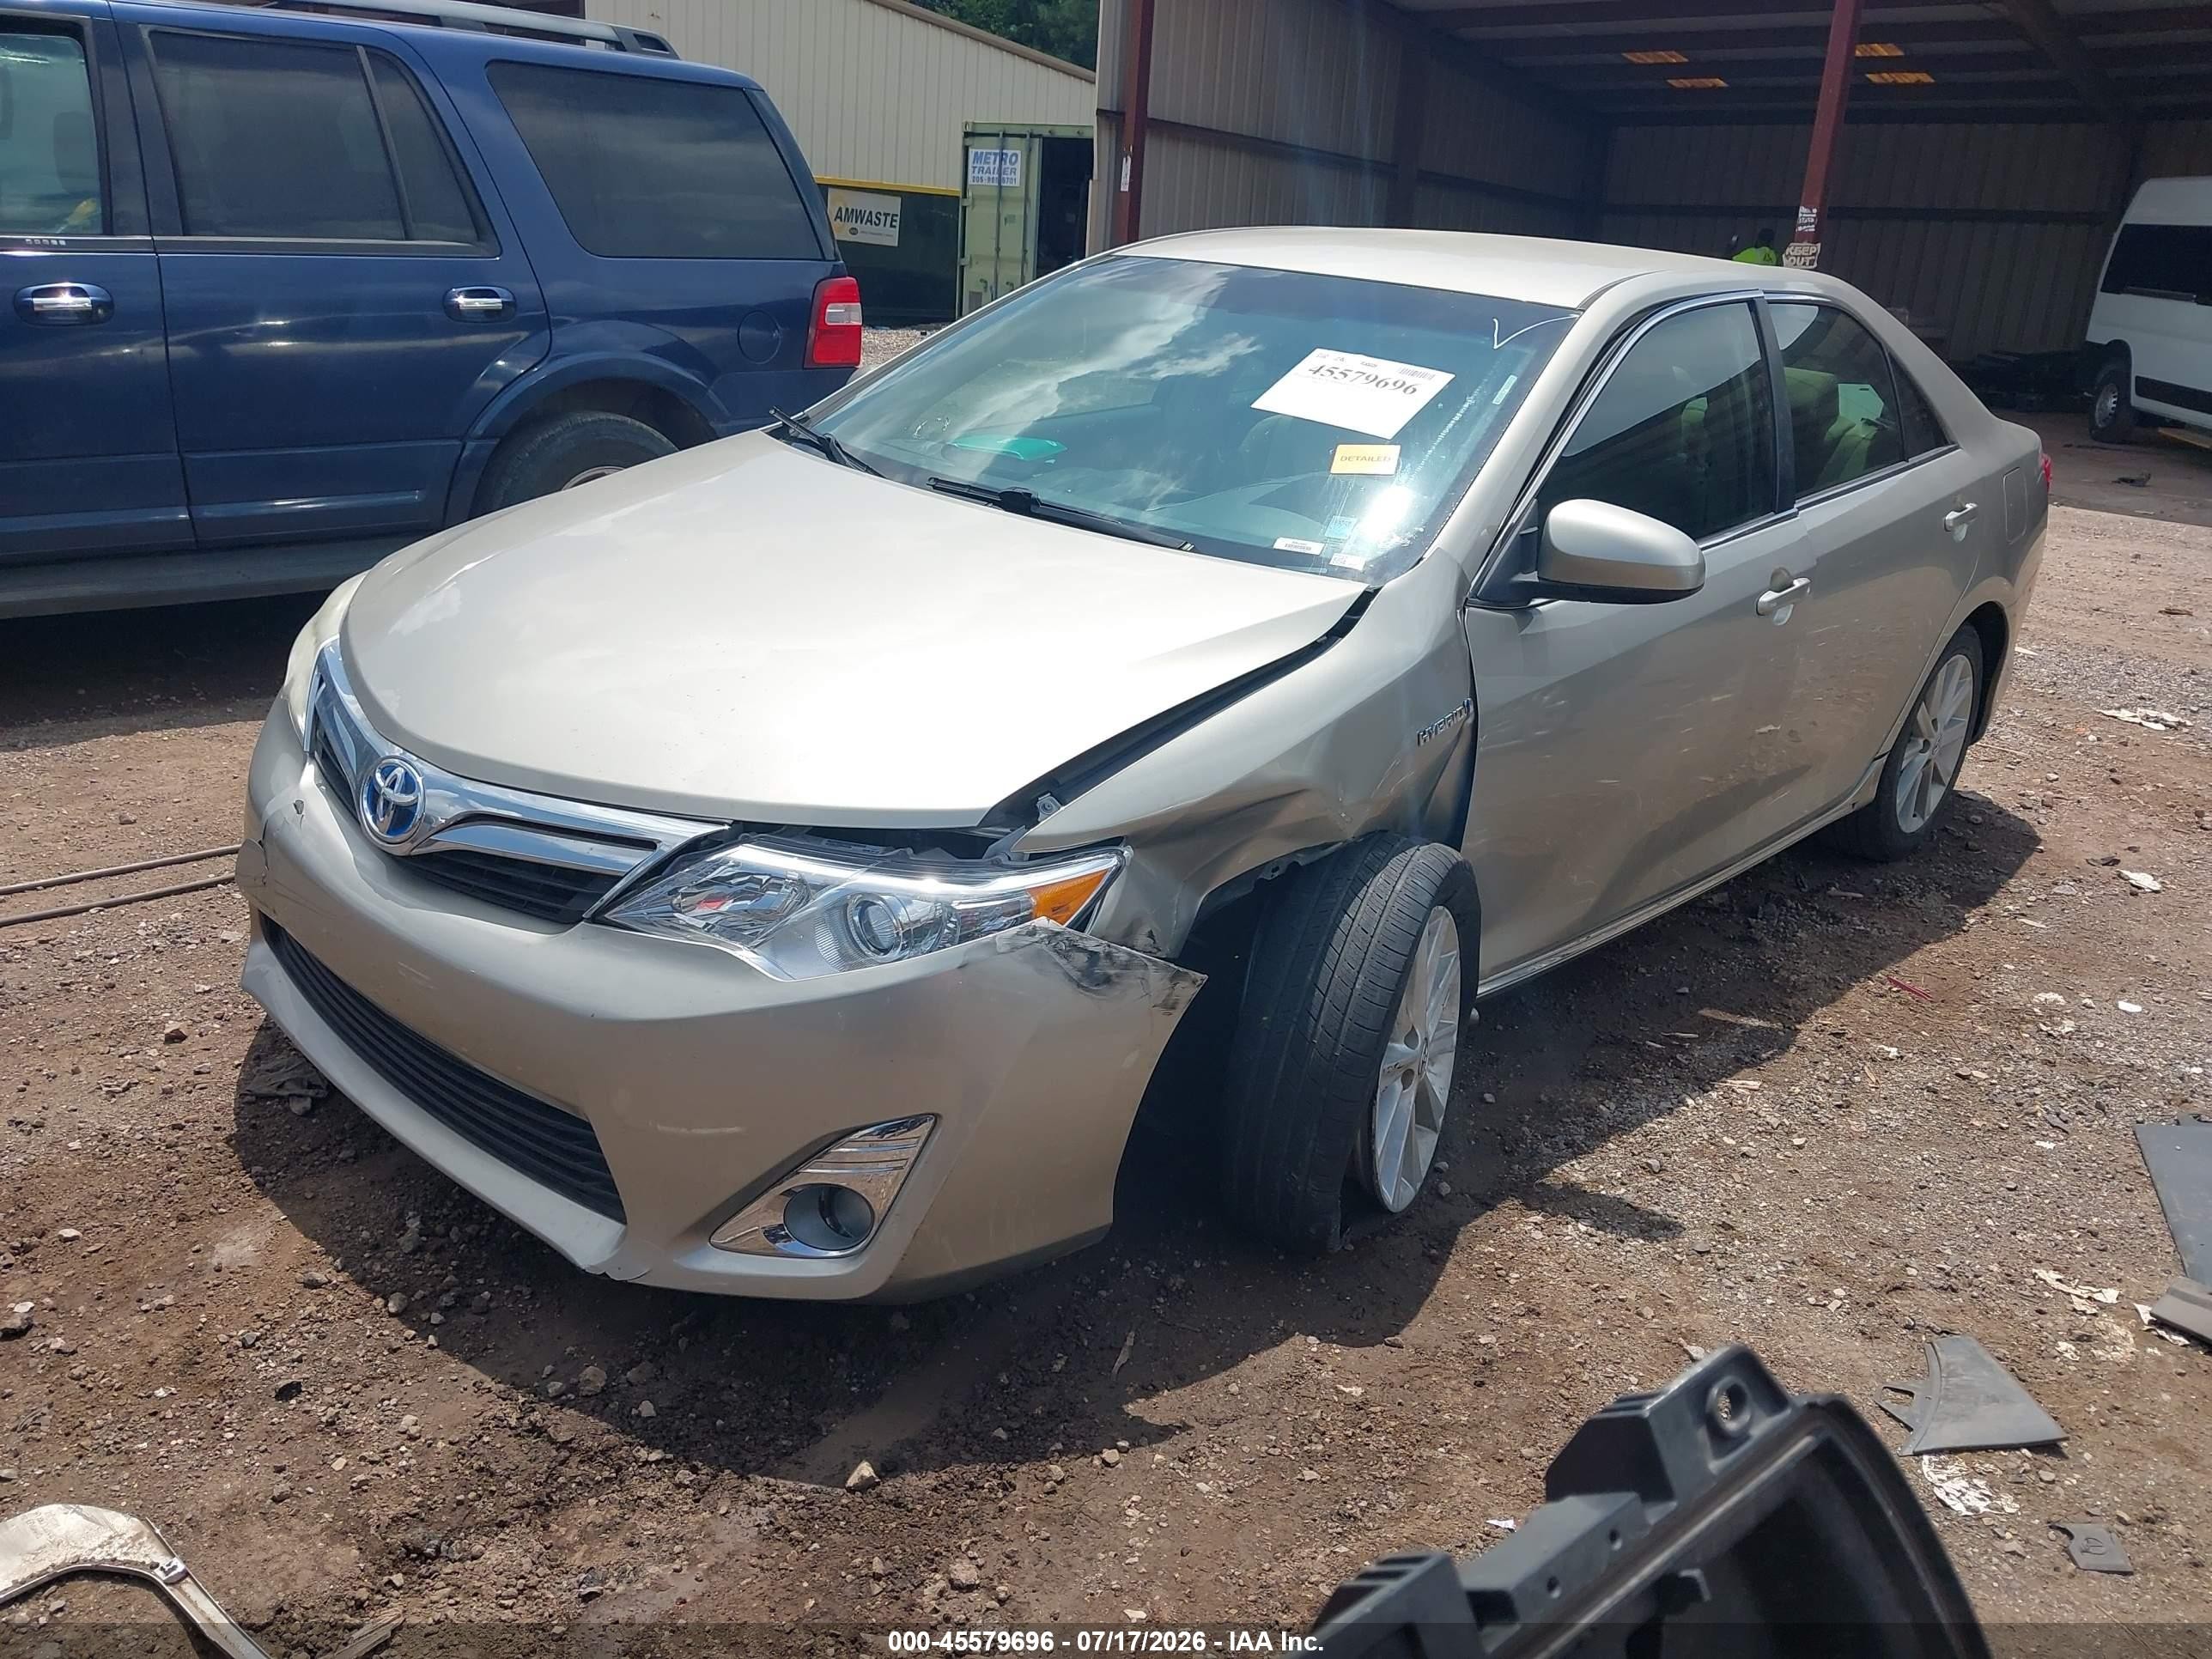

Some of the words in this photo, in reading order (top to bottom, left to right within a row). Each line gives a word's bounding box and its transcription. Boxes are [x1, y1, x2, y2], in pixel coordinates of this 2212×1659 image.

[973, 150, 1018, 166] METRO
[972, 166, 1017, 175] TRAIER
[834, 206, 899, 228] AMWASTE
[1786, 246, 1817, 256] KEEP
[1789, 255, 1815, 265] OUT
[1308, 364, 1421, 395] 45579696
[1418, 705, 1467, 746] HYBRID
